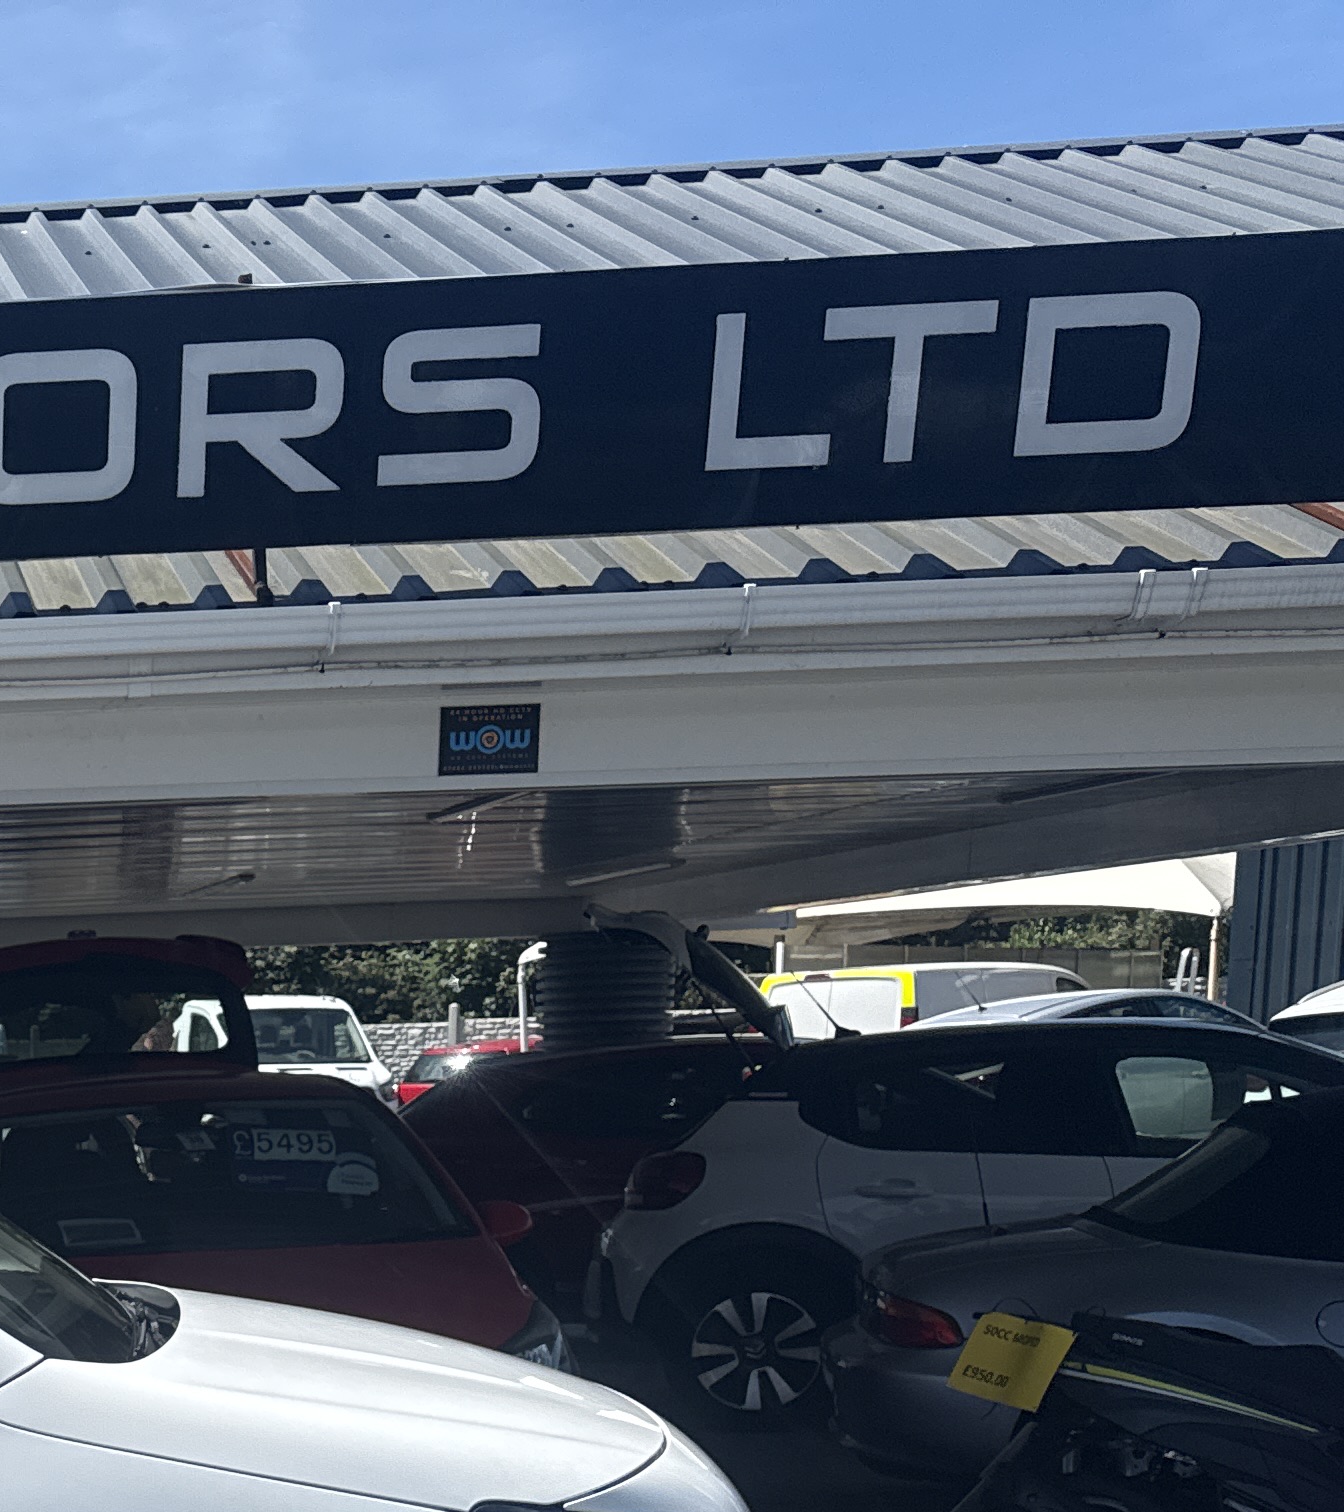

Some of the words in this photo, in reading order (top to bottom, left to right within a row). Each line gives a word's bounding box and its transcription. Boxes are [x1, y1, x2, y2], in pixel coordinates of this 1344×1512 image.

[704, 290, 1201, 471] LTD
[472, 714, 523, 722] OPERATION
[232, 1130, 334, 1156] £5495
[962, 1364, 1009, 1388] £950.00
